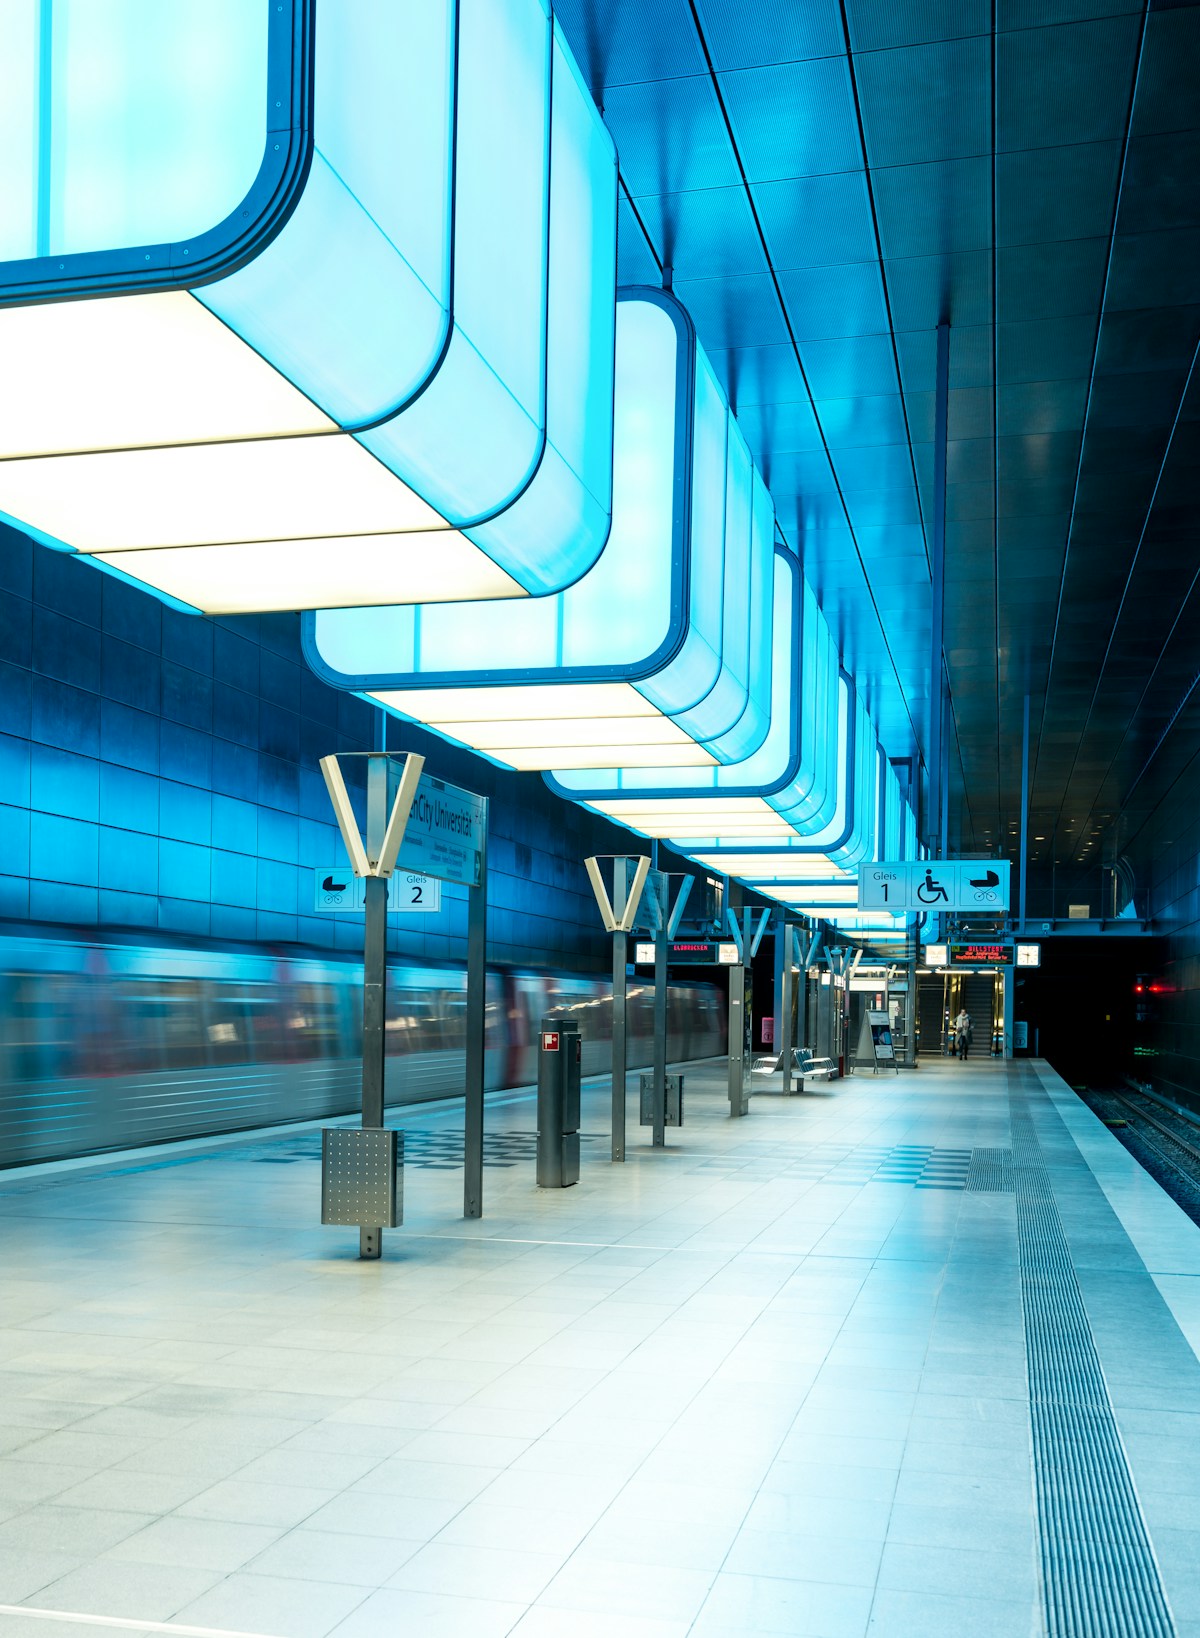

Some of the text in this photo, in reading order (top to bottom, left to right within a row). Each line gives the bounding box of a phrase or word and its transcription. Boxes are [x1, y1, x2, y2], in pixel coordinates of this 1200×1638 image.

[434, 799, 472, 838] Universität
[406, 875, 427, 884] Gleis
[873, 871, 897, 881] Gleis
[411, 886, 423, 904] 2
[880, 883, 888, 902] 1
